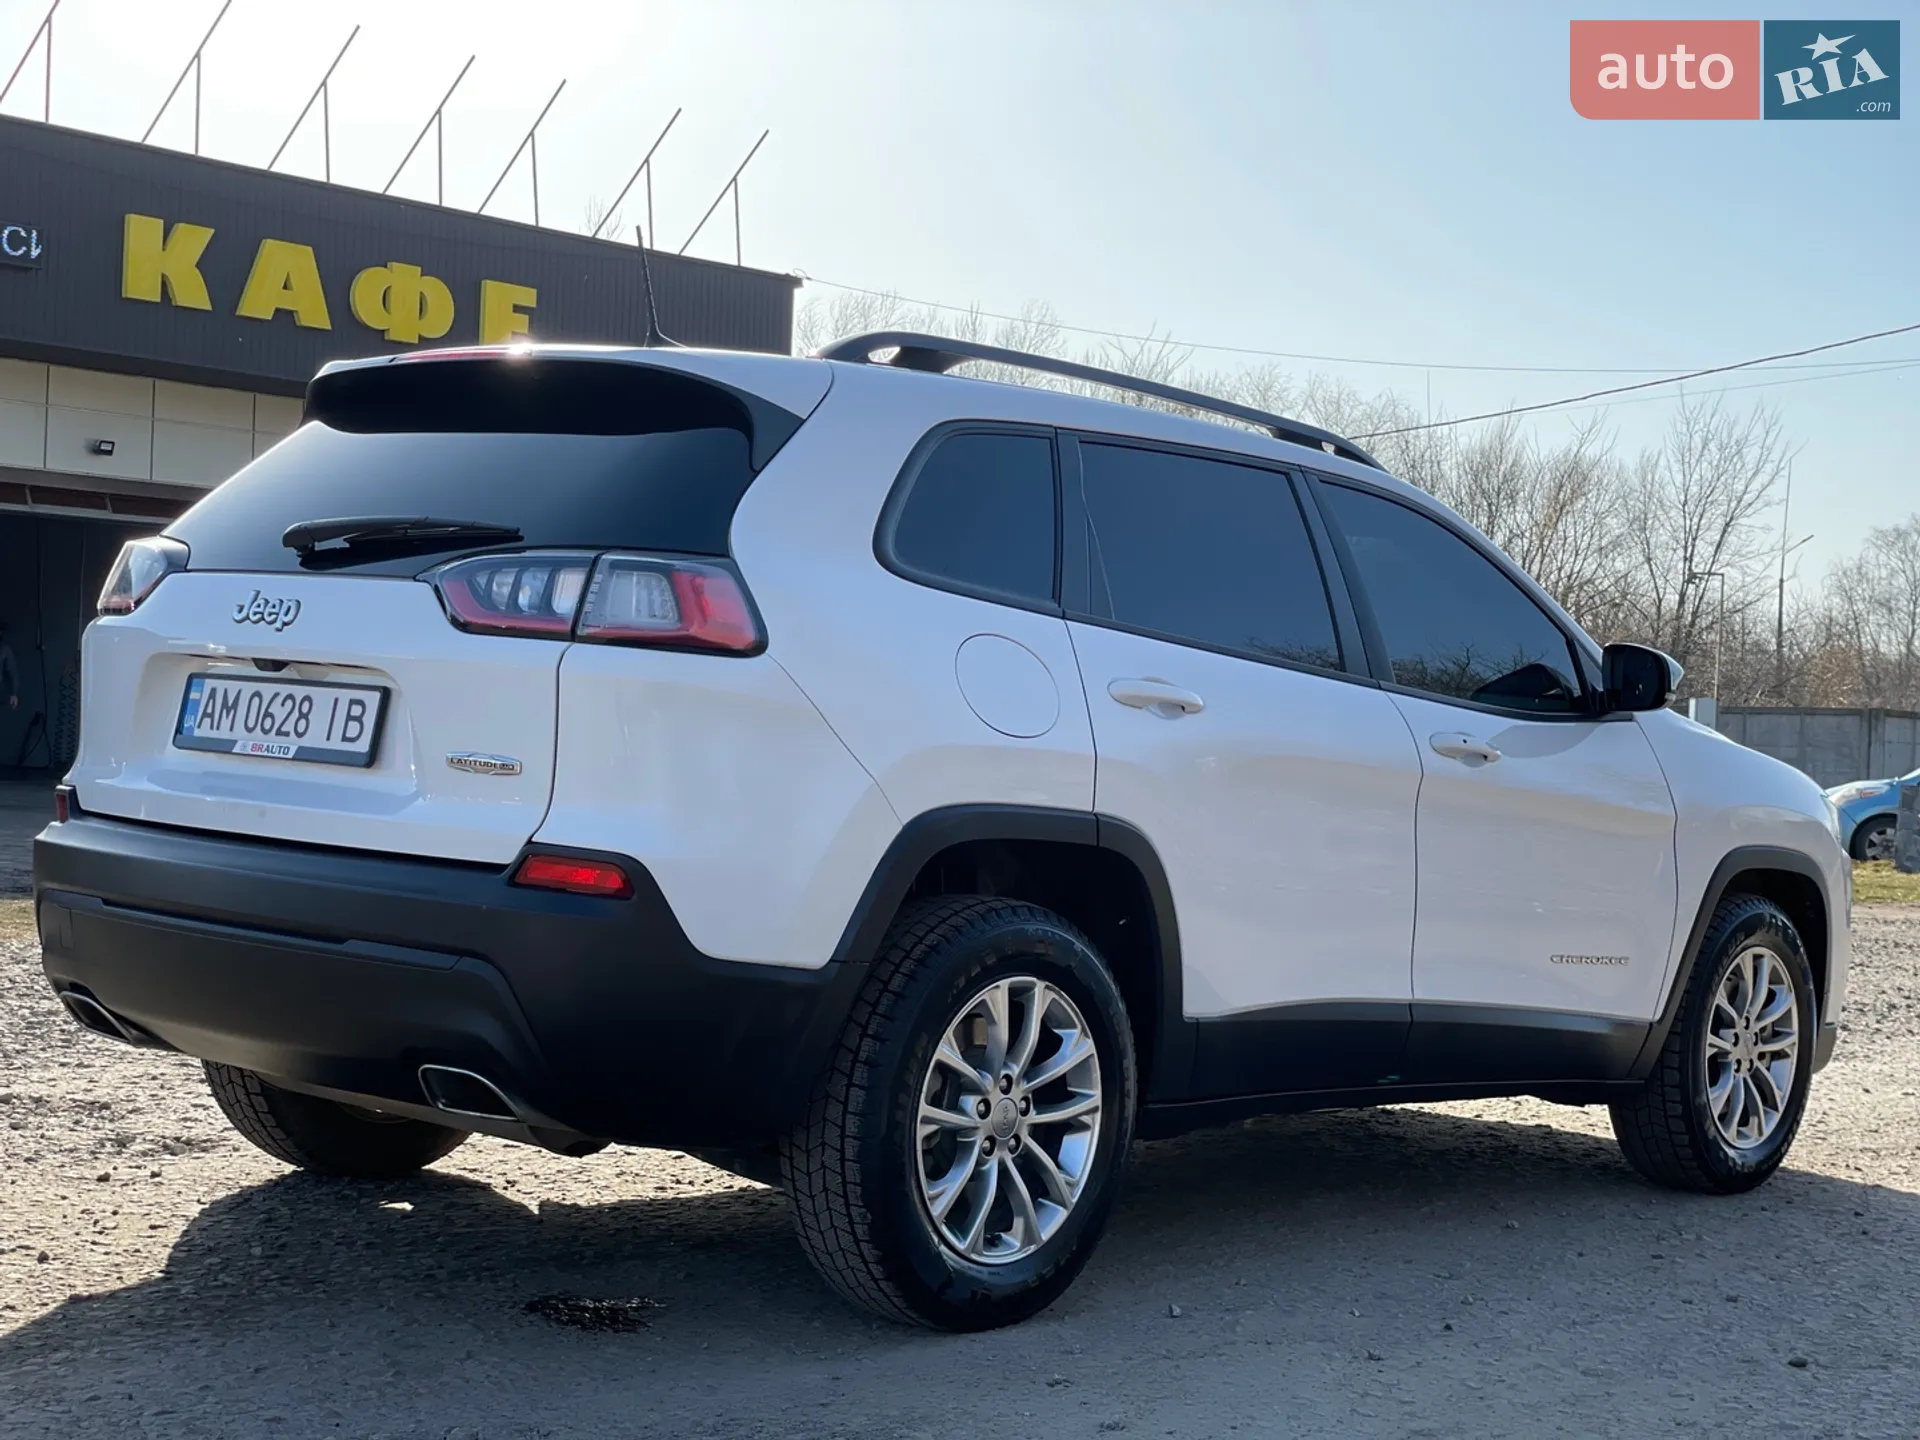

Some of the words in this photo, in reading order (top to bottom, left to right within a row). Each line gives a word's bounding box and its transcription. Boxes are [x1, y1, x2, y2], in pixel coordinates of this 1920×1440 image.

[122, 213, 537, 346] КАФЕ
[232, 589, 301, 632] Jeep
[197, 686, 242, 732] AM
[244, 690, 313, 738] 0628
[325, 696, 367, 743] IB
[250, 743, 291, 755] BRAUTO
[1550, 954, 1630, 966] CHEROKEE
